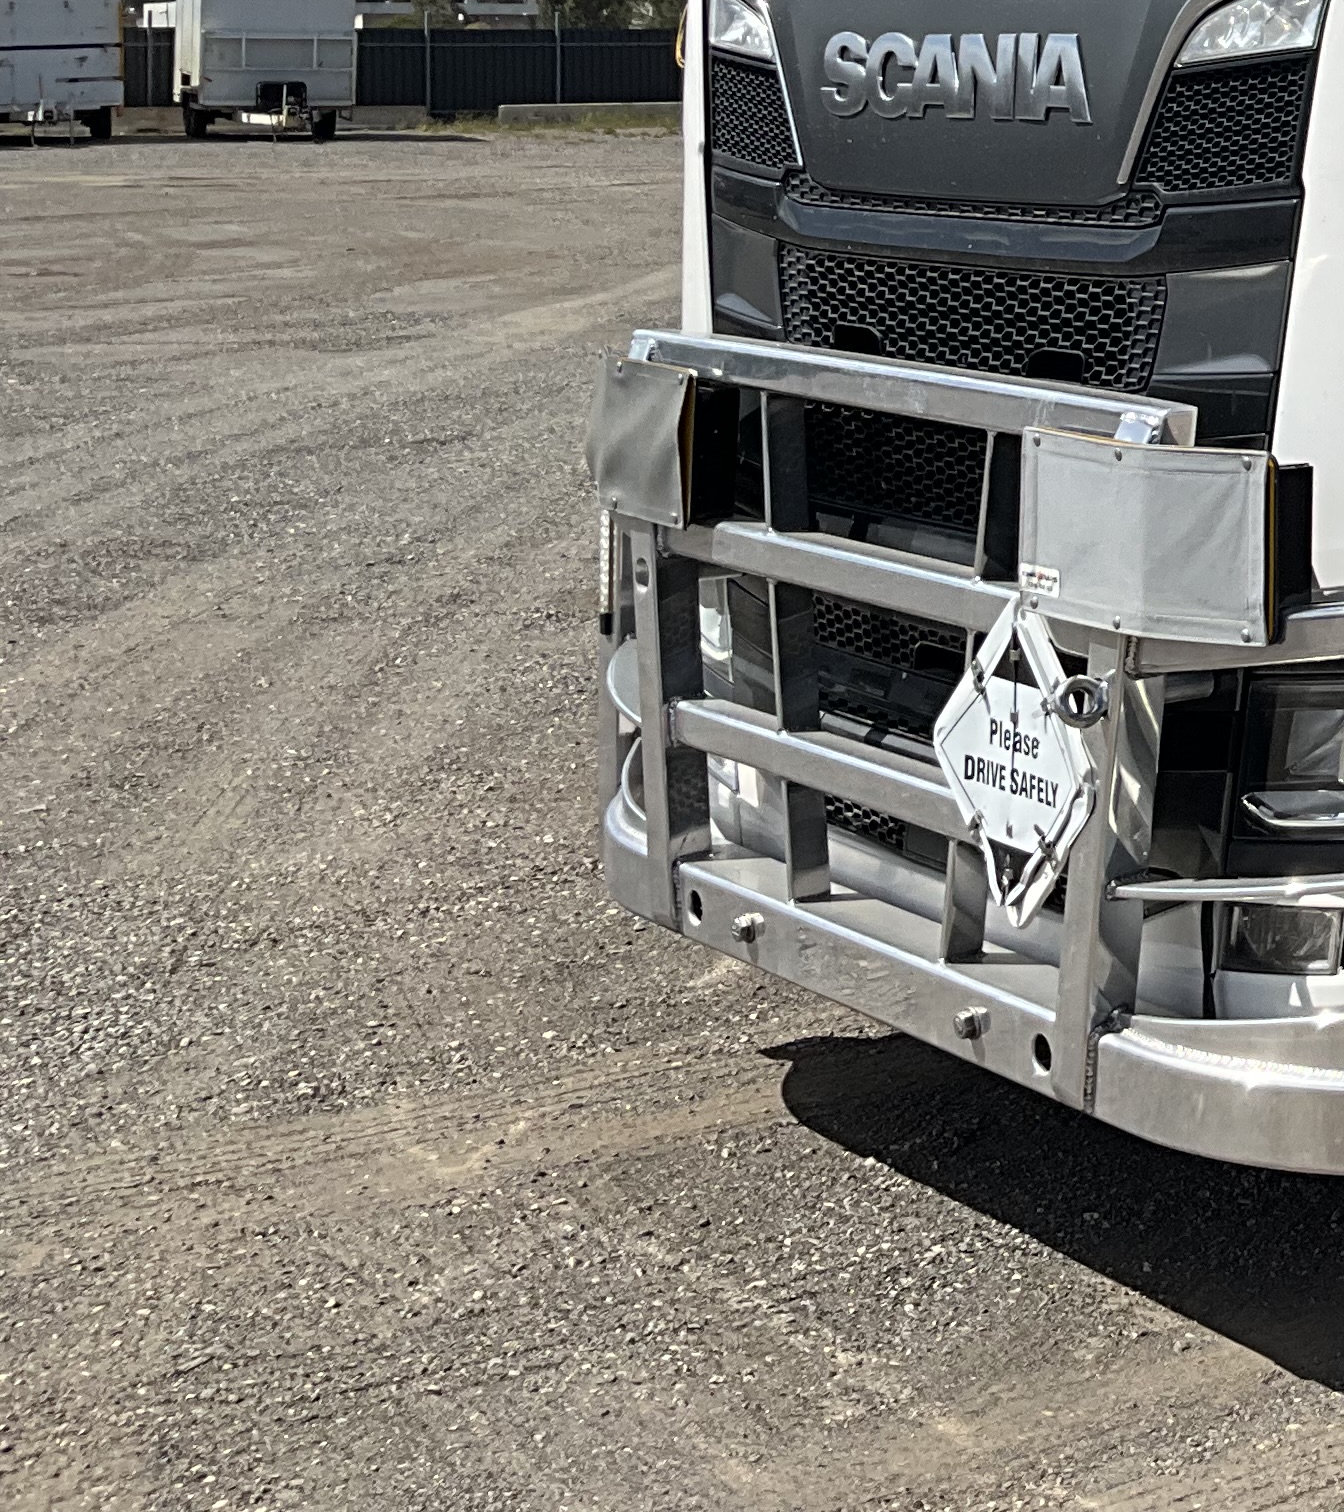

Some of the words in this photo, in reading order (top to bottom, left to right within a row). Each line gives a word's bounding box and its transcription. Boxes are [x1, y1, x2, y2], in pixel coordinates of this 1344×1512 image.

[821, 31, 1093, 124] SCANIA
[989, 717, 1040, 759] Please
[964, 754, 1006, 791] DRIVE
[1009, 767, 1059, 809] SAFELY
